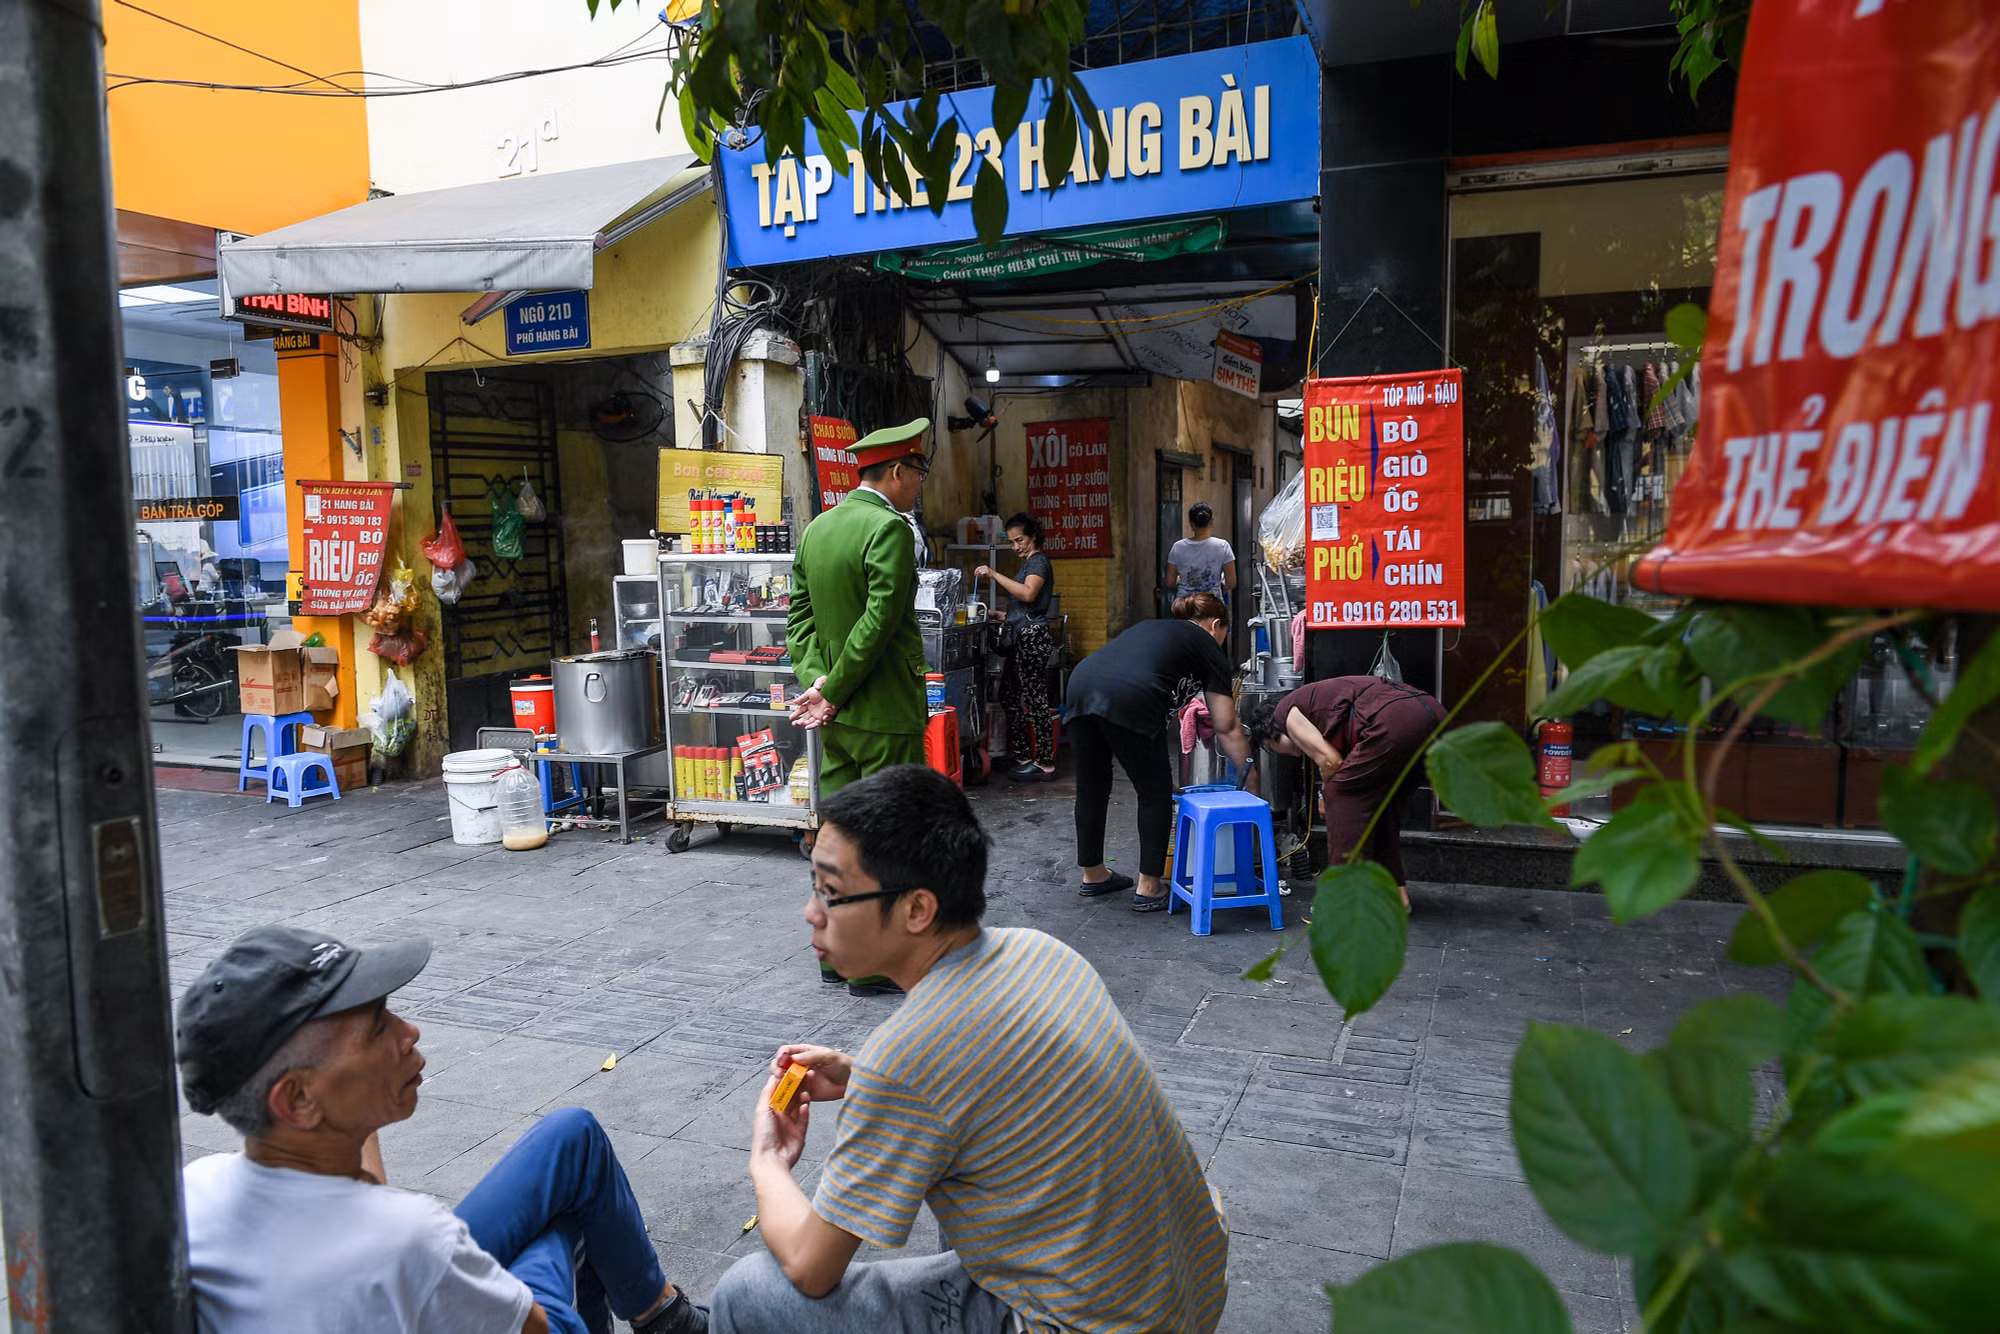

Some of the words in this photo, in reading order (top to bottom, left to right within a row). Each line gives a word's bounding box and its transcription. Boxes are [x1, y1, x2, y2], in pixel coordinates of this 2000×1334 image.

[751, 144, 833, 237] TẬP
[1179, 73, 1270, 170] BÀI
[519, 302, 546, 325] NGÕ
[548, 302, 573, 321] 21D
[297, 331, 311, 348] BÀI
[515, 327, 535, 345] PHỐ
[536, 326, 561, 343] HÀNG
[562, 324, 579, 341] BÀI
[1217, 367, 1235, 386] SIM
[1383, 383, 1404, 408] TÓP
[1407, 381, 1425, 406] MỠ
[1434, 379, 1458, 408] ĐẬU
[813, 421, 835, 440] CHÁO
[1309, 398, 1360, 443] BÚN
[1383, 415, 1419, 444] BÒ
[1029, 427, 1068, 469] XÔI
[1068, 442, 1083, 458] CÔ
[1085, 443, 1107, 456] LAN
[1383, 449, 1428, 479] GIÒ
[1713, 393, 1824, 530] THẺ
[1817, 387, 1991, 544] ĐIỆN
[1065, 473, 1082, 489] LẠP
[1310, 458, 1366, 504] RIÊU
[359, 498, 375, 511] BÀI
[1031, 491, 1060, 509] TRỨNG
[1068, 494, 1087, 510] THỊT
[1088, 493, 1108, 507] KHO
[1384, 483, 1419, 513] ỐC
[141, 501, 167, 520] BÁN
[170, 500, 193, 518] TRẢ
[197, 500, 224, 518] GÓP
[327, 514, 348, 525] 0915
[349, 515, 365, 526] 390
[367, 515, 383, 526] 183
[1061, 512, 1080, 529] XÚC
[1081, 512, 1104, 529] XÍCH
[359, 528, 383, 545] BÒ
[1383, 525, 1421, 552] TÁI
[308, 530, 355, 583] RIÊU
[1313, 534, 1365, 581] PHỞ
[355, 568, 375, 586] ỐC
[1384, 559, 1443, 586] CHÍN
[311, 587, 341, 598] TRỨNG
[310, 599, 329, 610] SỮA
[1312, 601, 1338, 623] ĐT:
[1342, 601, 1385, 623] 0916
[1389, 600, 1422, 622] 280
[1427, 600, 1458, 622] 531
